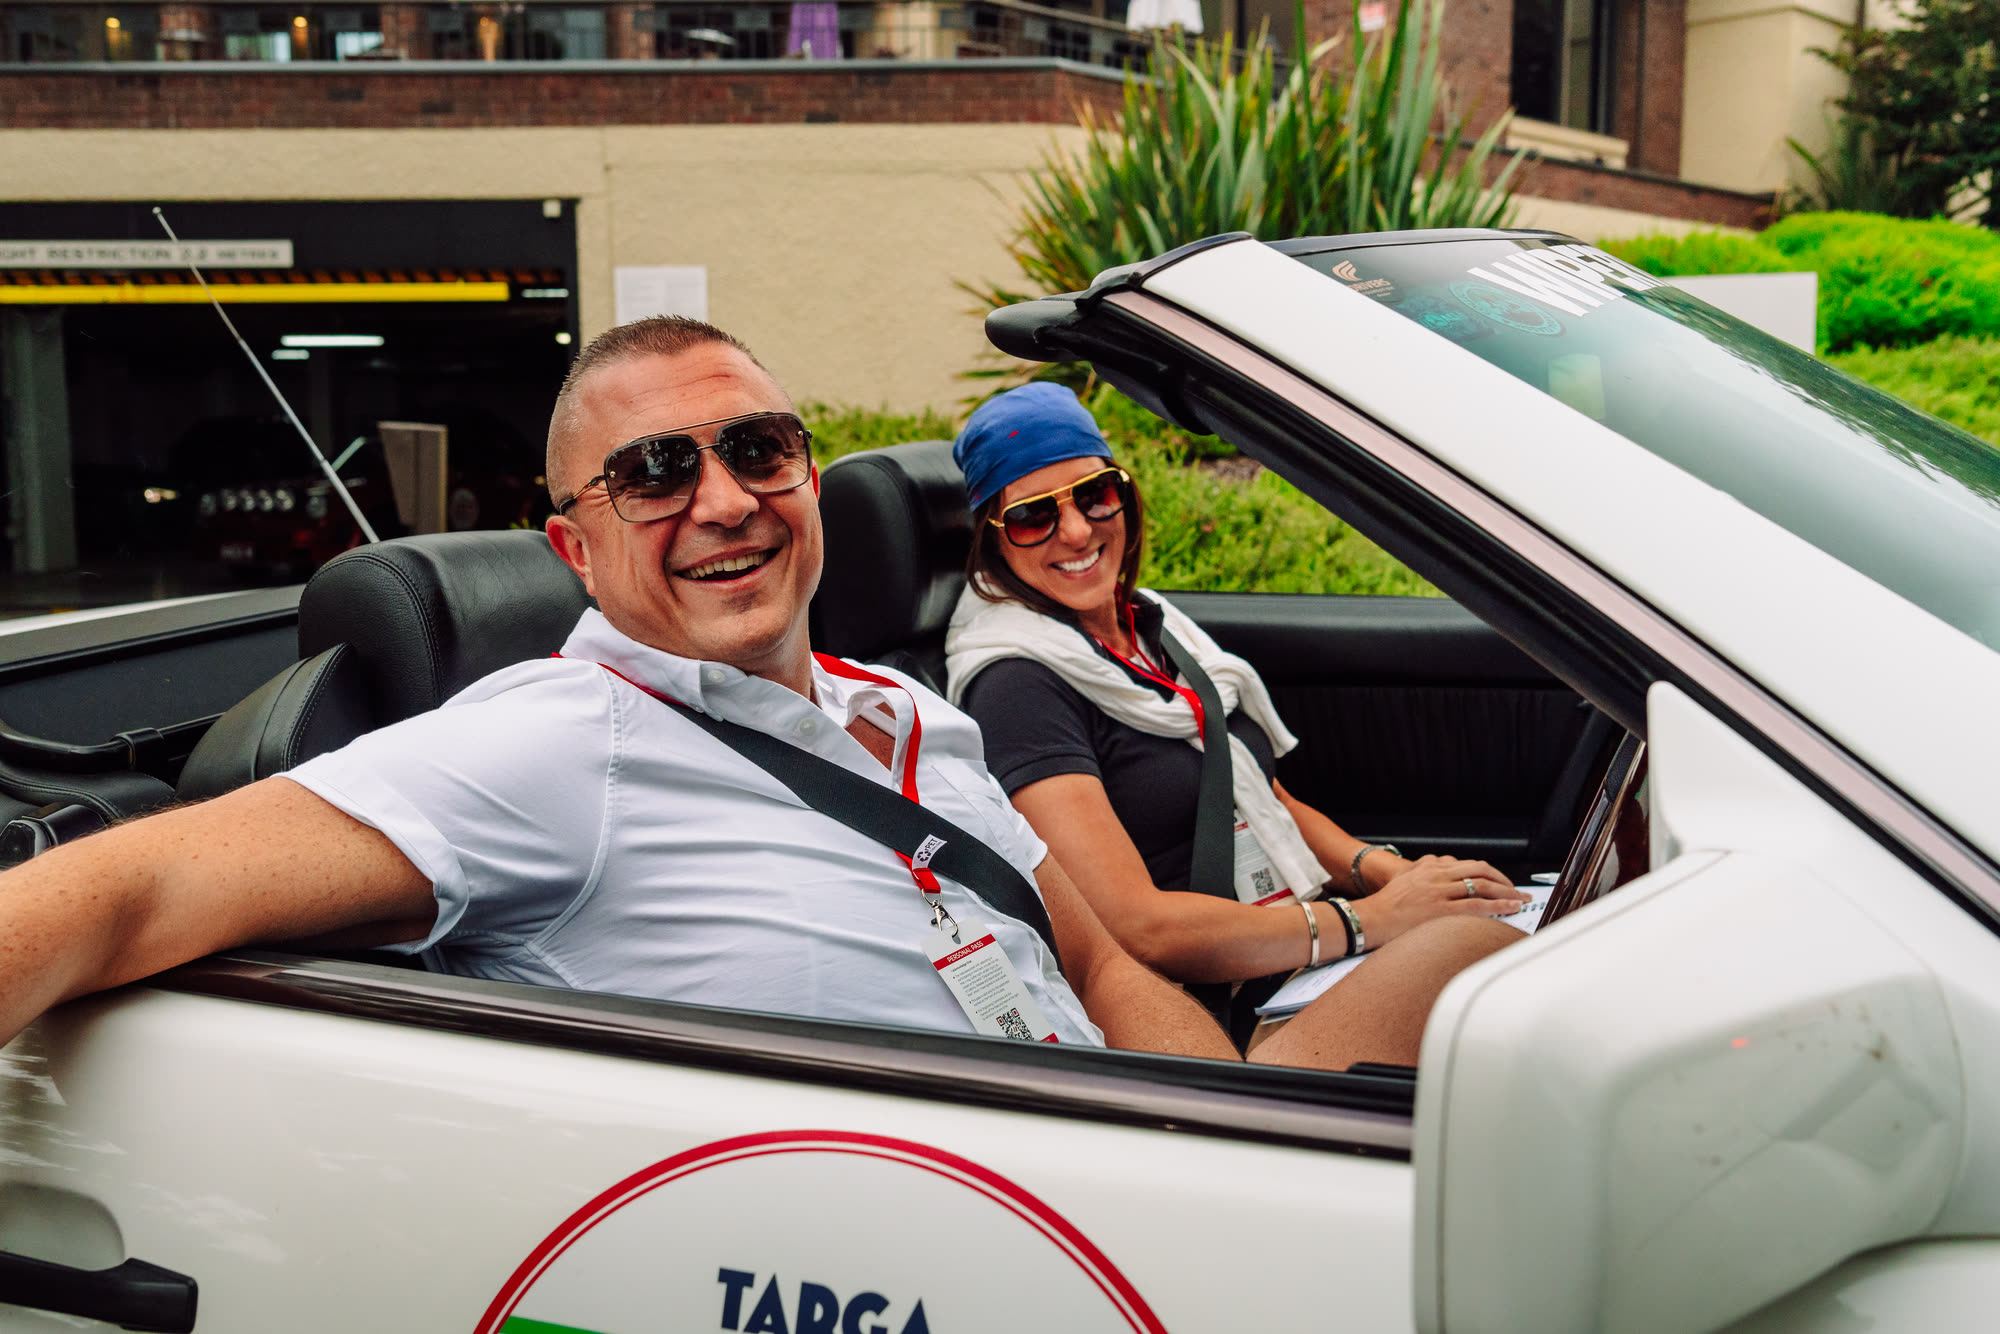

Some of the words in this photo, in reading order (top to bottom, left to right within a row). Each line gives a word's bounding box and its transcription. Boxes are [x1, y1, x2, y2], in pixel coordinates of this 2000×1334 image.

[47, 247, 172, 261] RESTRICTION
[946, 947, 973, 963] PERSONAL
[970, 940, 984, 951] PASS
[717, 1267, 931, 1334] TARGA
